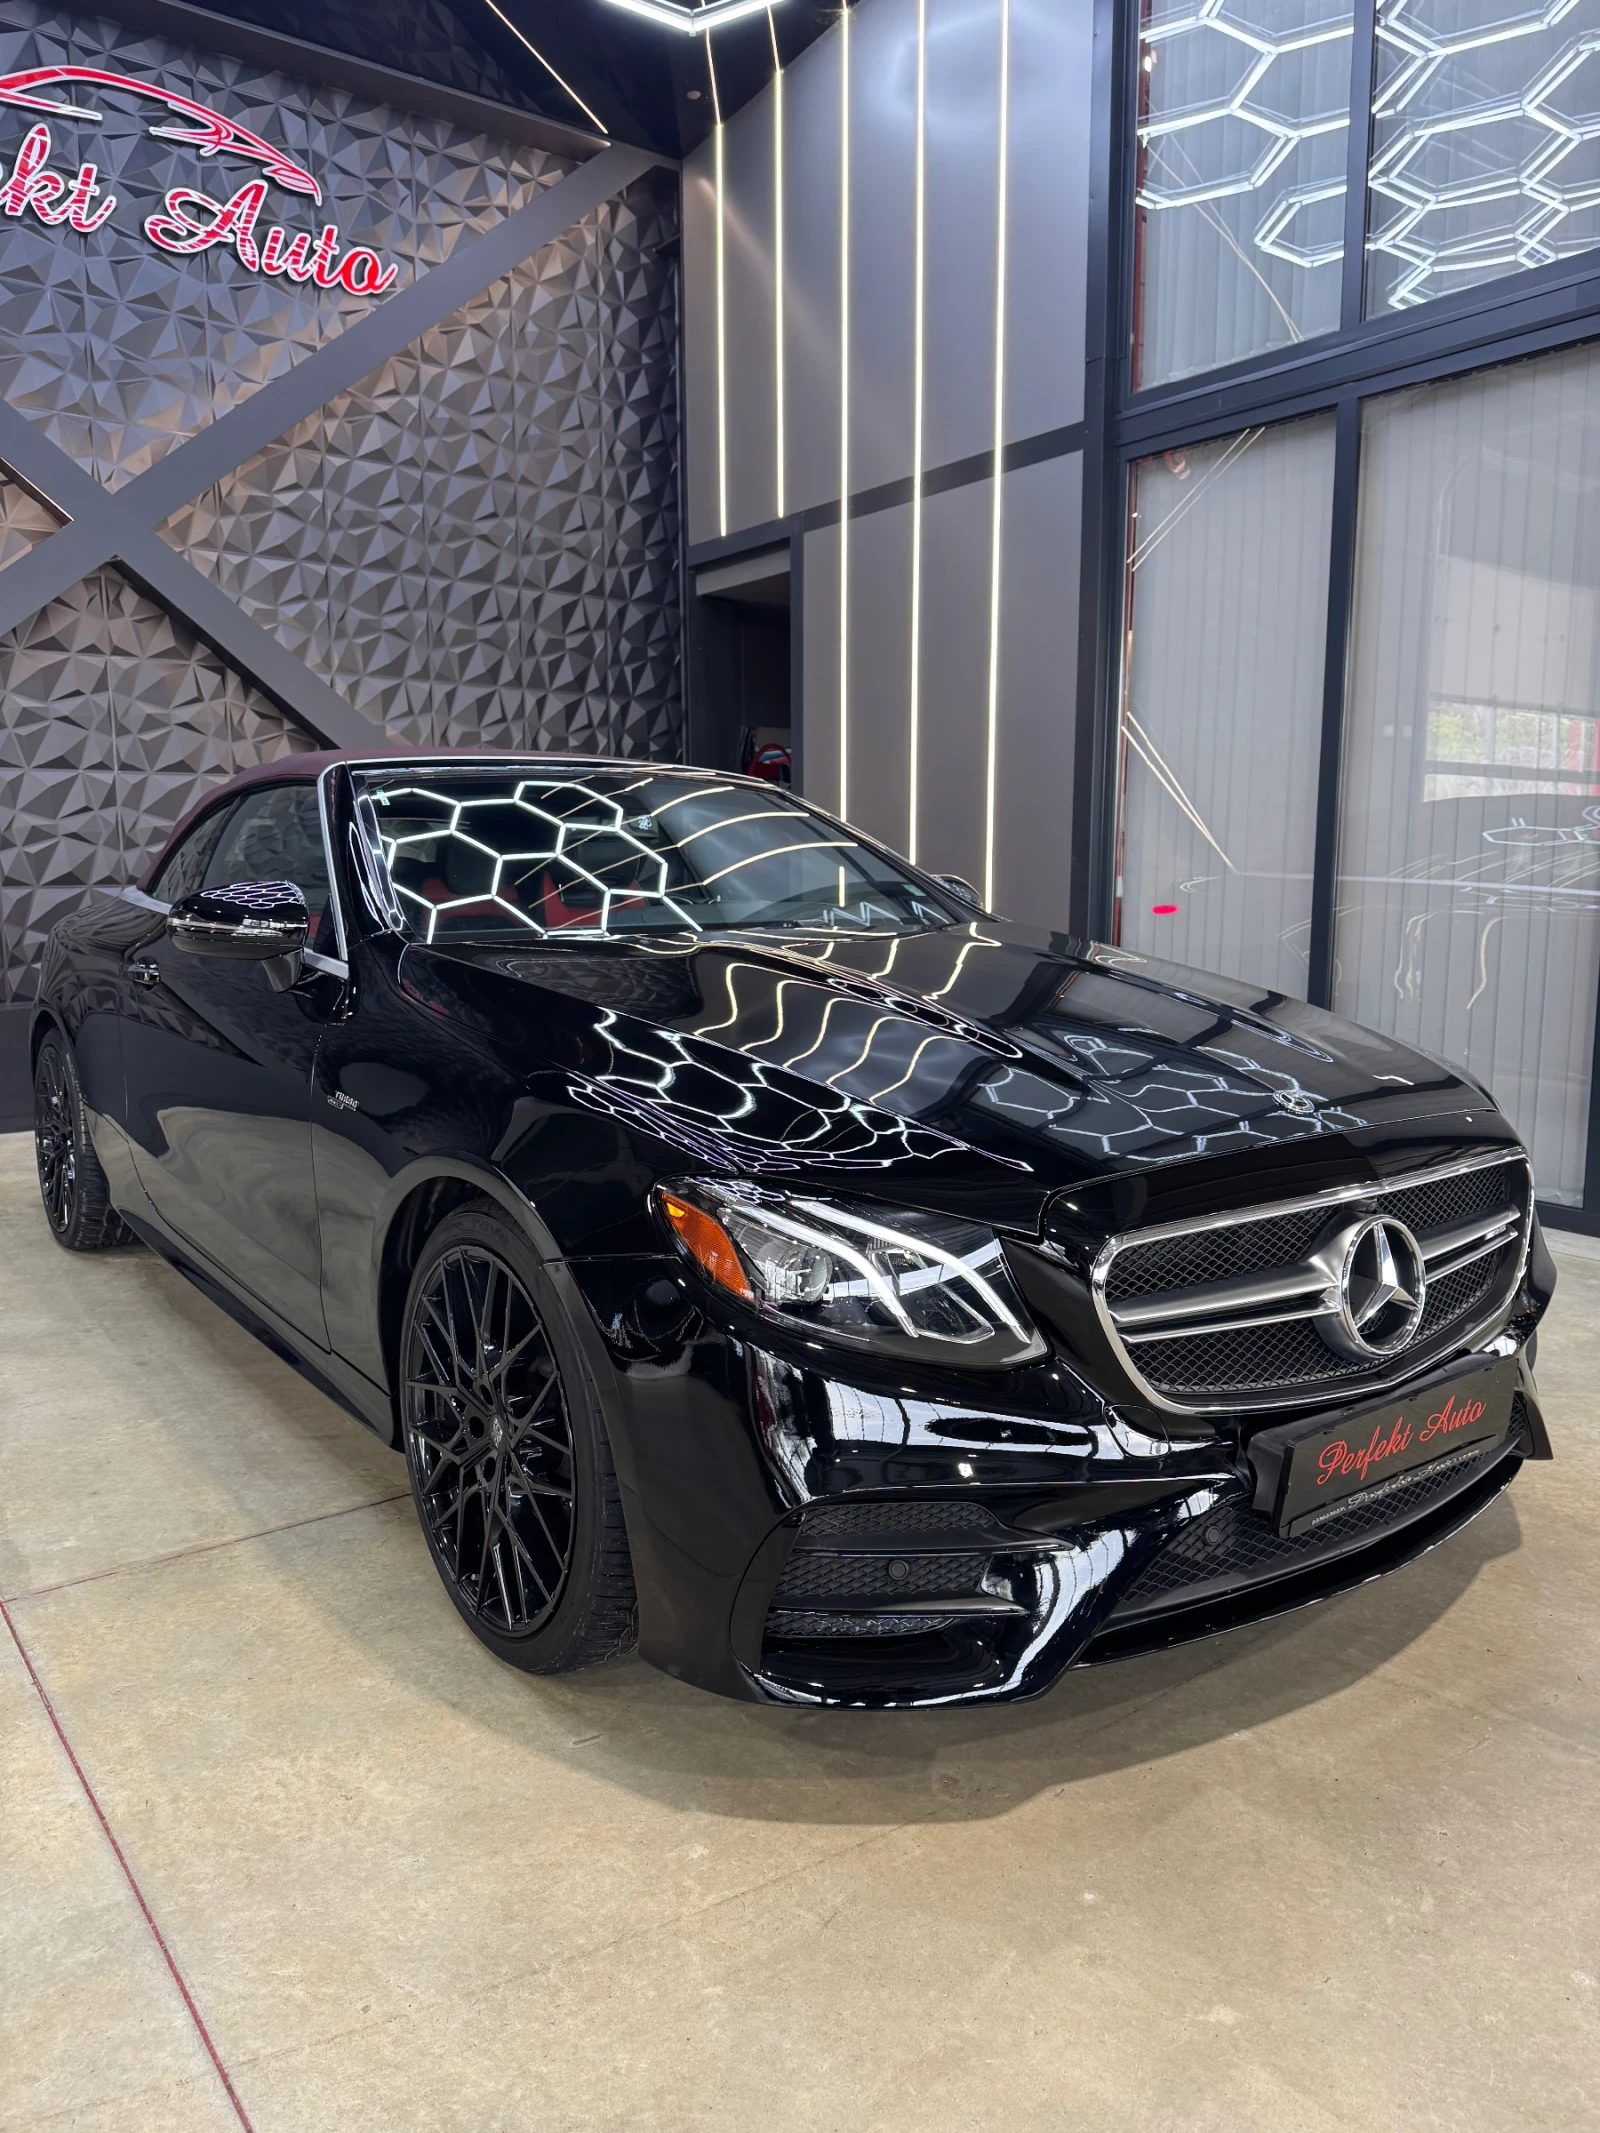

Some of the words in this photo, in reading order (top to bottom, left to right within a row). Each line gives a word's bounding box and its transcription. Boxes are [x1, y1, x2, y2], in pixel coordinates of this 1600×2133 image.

[0, 123, 117, 232] kt
[144, 179, 398, 295] Auto
[1316, 1416, 1413, 1485] Perfekt
[1419, 1395, 1487, 1443] Auto
